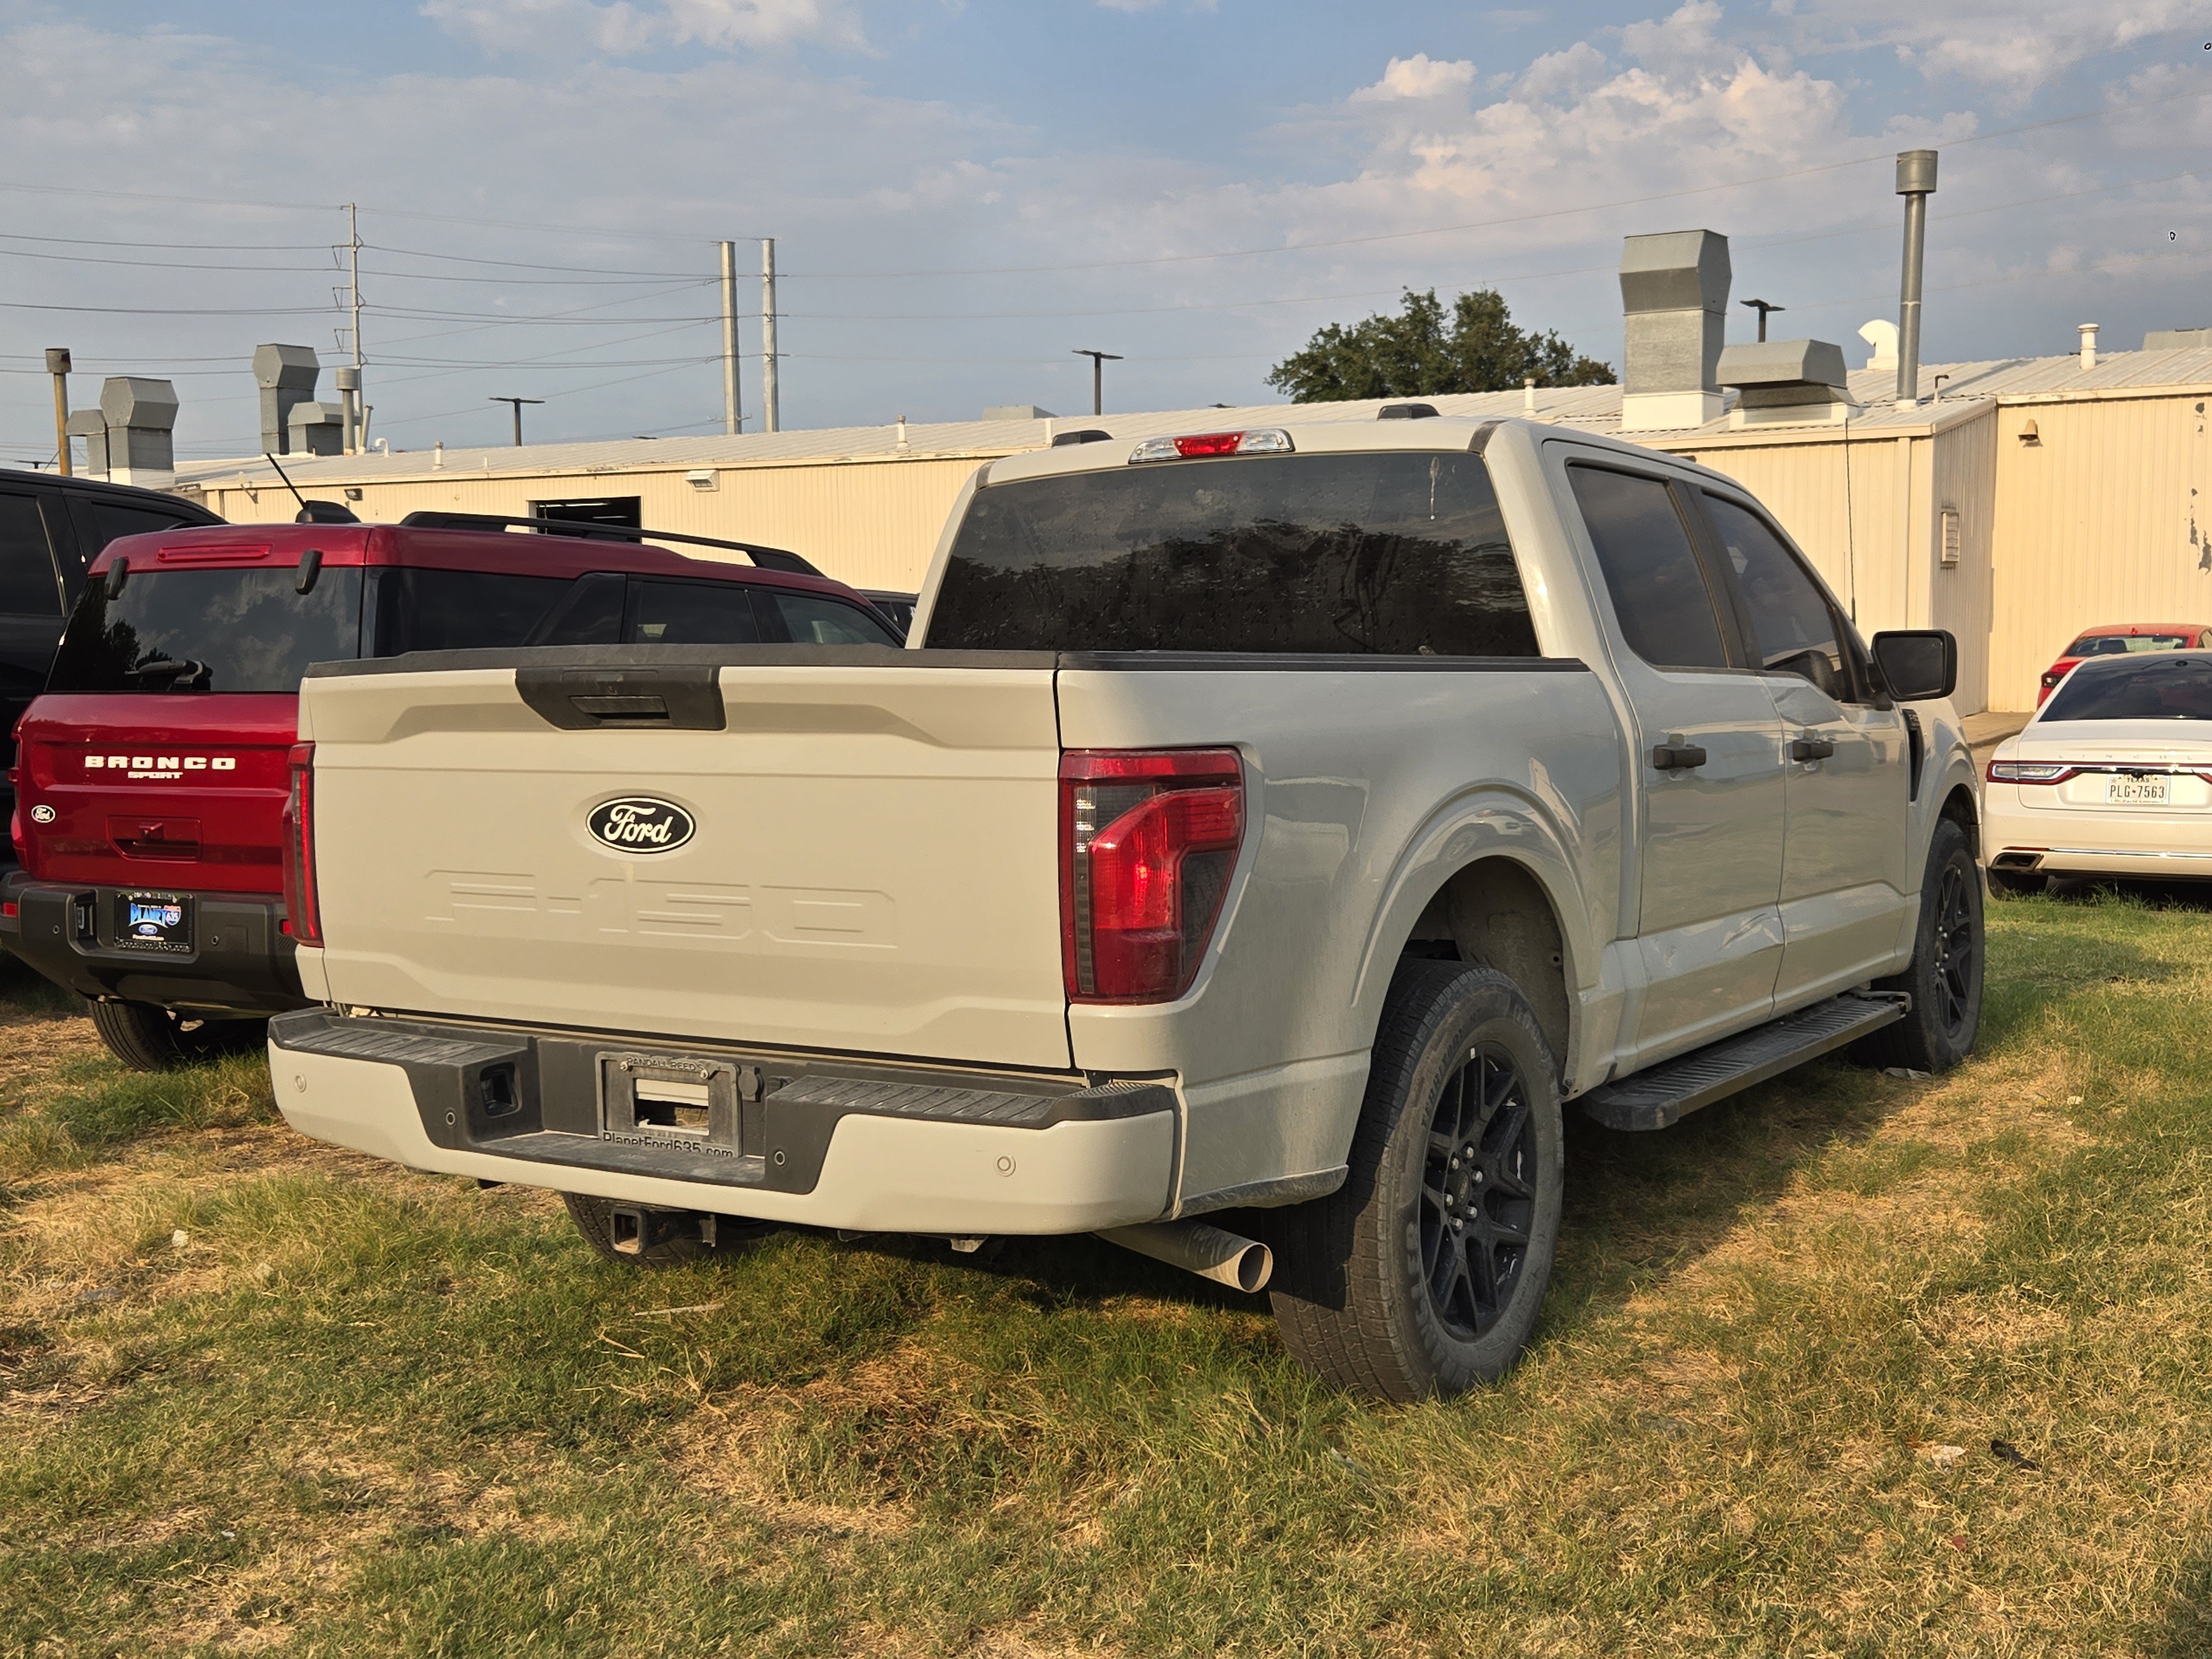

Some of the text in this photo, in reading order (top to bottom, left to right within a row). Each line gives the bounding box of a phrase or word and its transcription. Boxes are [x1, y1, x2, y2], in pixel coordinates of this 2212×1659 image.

[85, 755, 236, 770] BRONCO
[604, 805, 674, 843] Ford
[131, 902, 167, 925] PLANET
[627, 1057, 669, 1068] RANDALL
[603, 1131, 733, 1157] PlanetFord635com
